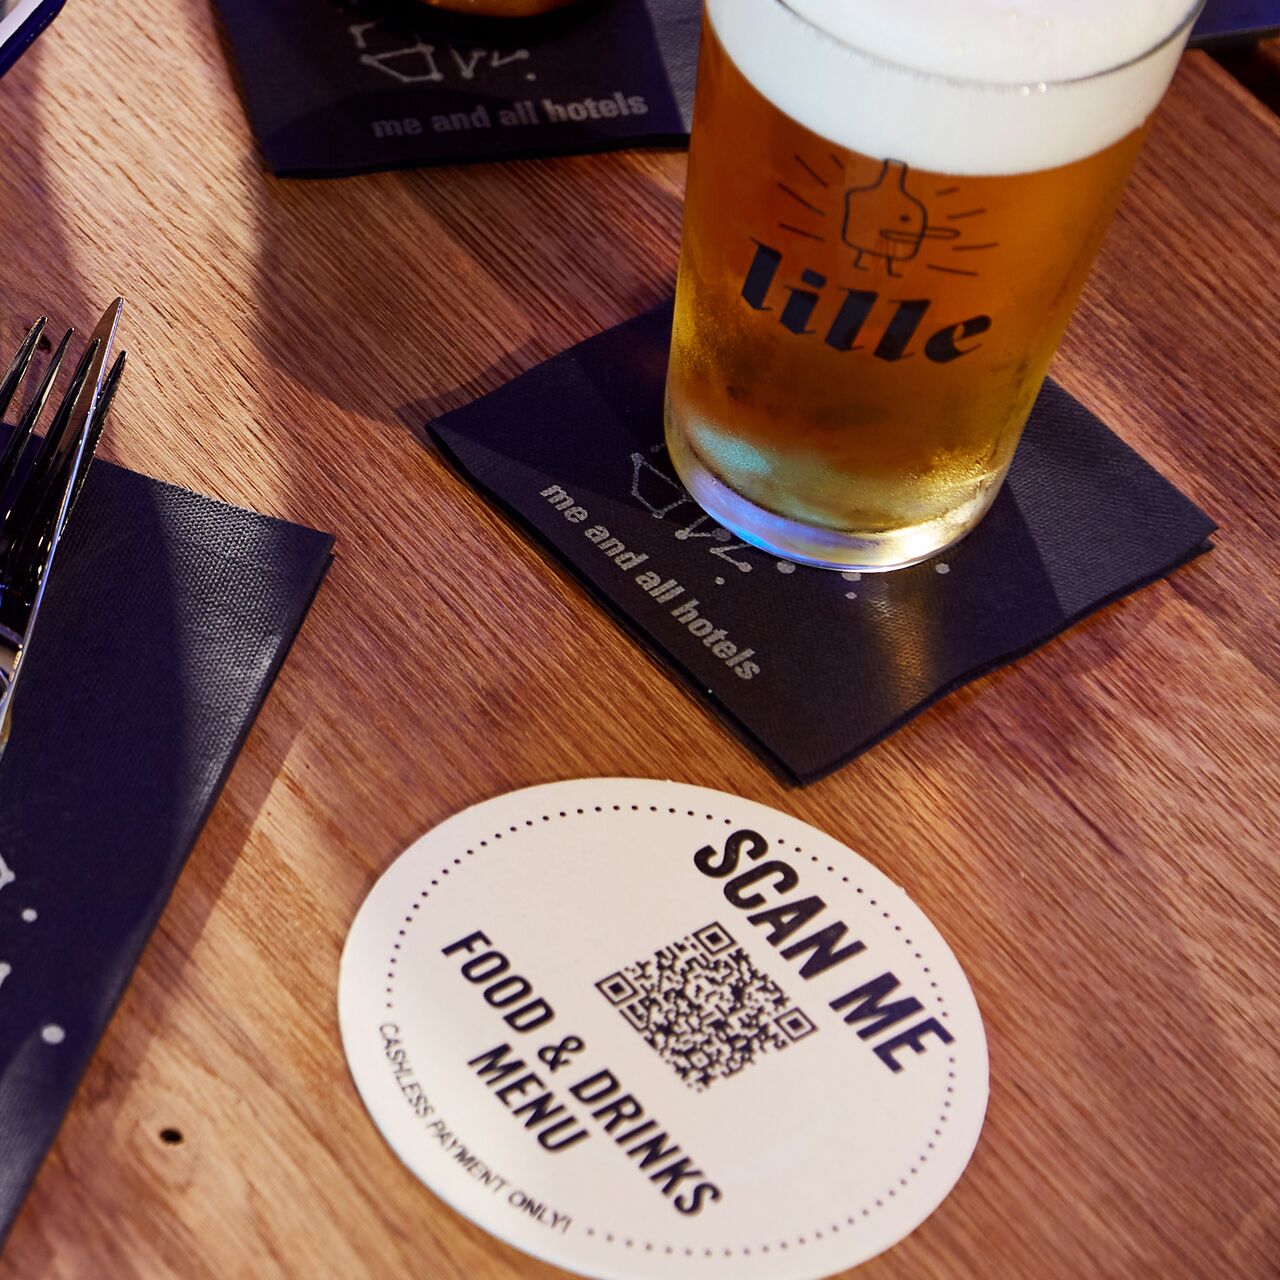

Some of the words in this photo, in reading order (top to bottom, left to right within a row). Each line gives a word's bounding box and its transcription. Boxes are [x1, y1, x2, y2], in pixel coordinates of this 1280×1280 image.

[370, 117, 423, 138] me
[432, 105, 491, 133] and
[499, 100, 540, 126] all
[542, 92, 649, 123] hotels
[741, 237, 992, 363] lille
[540, 484, 588, 524] me
[584, 524, 650, 571] and
[635, 570, 686, 604] all
[670, 598, 761, 680] hotels
[694, 828, 868, 981] SCAN
[828, 971, 955, 1074] ME
[379, 1022, 436, 1119] CASHLESS
[426, 1119, 509, 1194] PAYMENT
[441, 930, 556, 1035] FOOD
[537, 1034, 586, 1073] &
[567, 1066, 723, 1219] DRINKS
[467, 1042, 593, 1155] MENU
